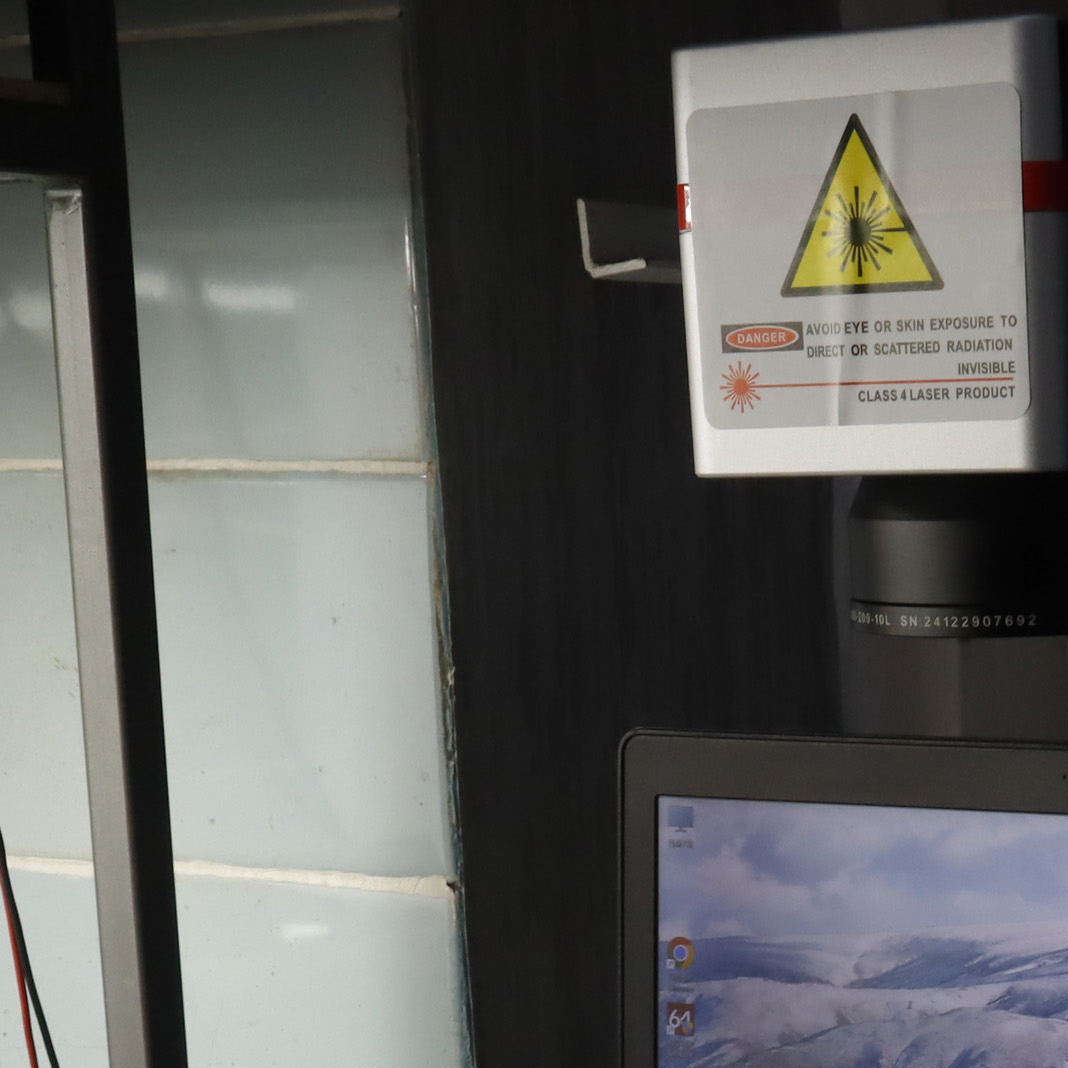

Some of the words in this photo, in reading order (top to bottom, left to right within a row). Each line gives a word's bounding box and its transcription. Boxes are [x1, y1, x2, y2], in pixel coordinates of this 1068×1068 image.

[806, 322, 841, 336] AVOID
[844, 321, 869, 335] EYE
[874, 320, 891, 333] OR
[896, 318, 924, 332] SKIN
[930, 316, 994, 331] EXPOSURE
[1000, 315, 1017, 327] TO
[737, 331, 786, 345] DANGER
[806, 344, 845, 358] DIRECT
[851, 343, 868, 356] OR
[874, 341, 941, 356] SCATTERED
[947, 338, 1013, 353] RADIATION
[958, 361, 1016, 375] INVISIBLE
[858, 389, 897, 402] CLASS
[900, 388, 907, 401] 4
[910, 387, 950, 401] LASER
[955, 385, 1016, 399] PRODUCT
